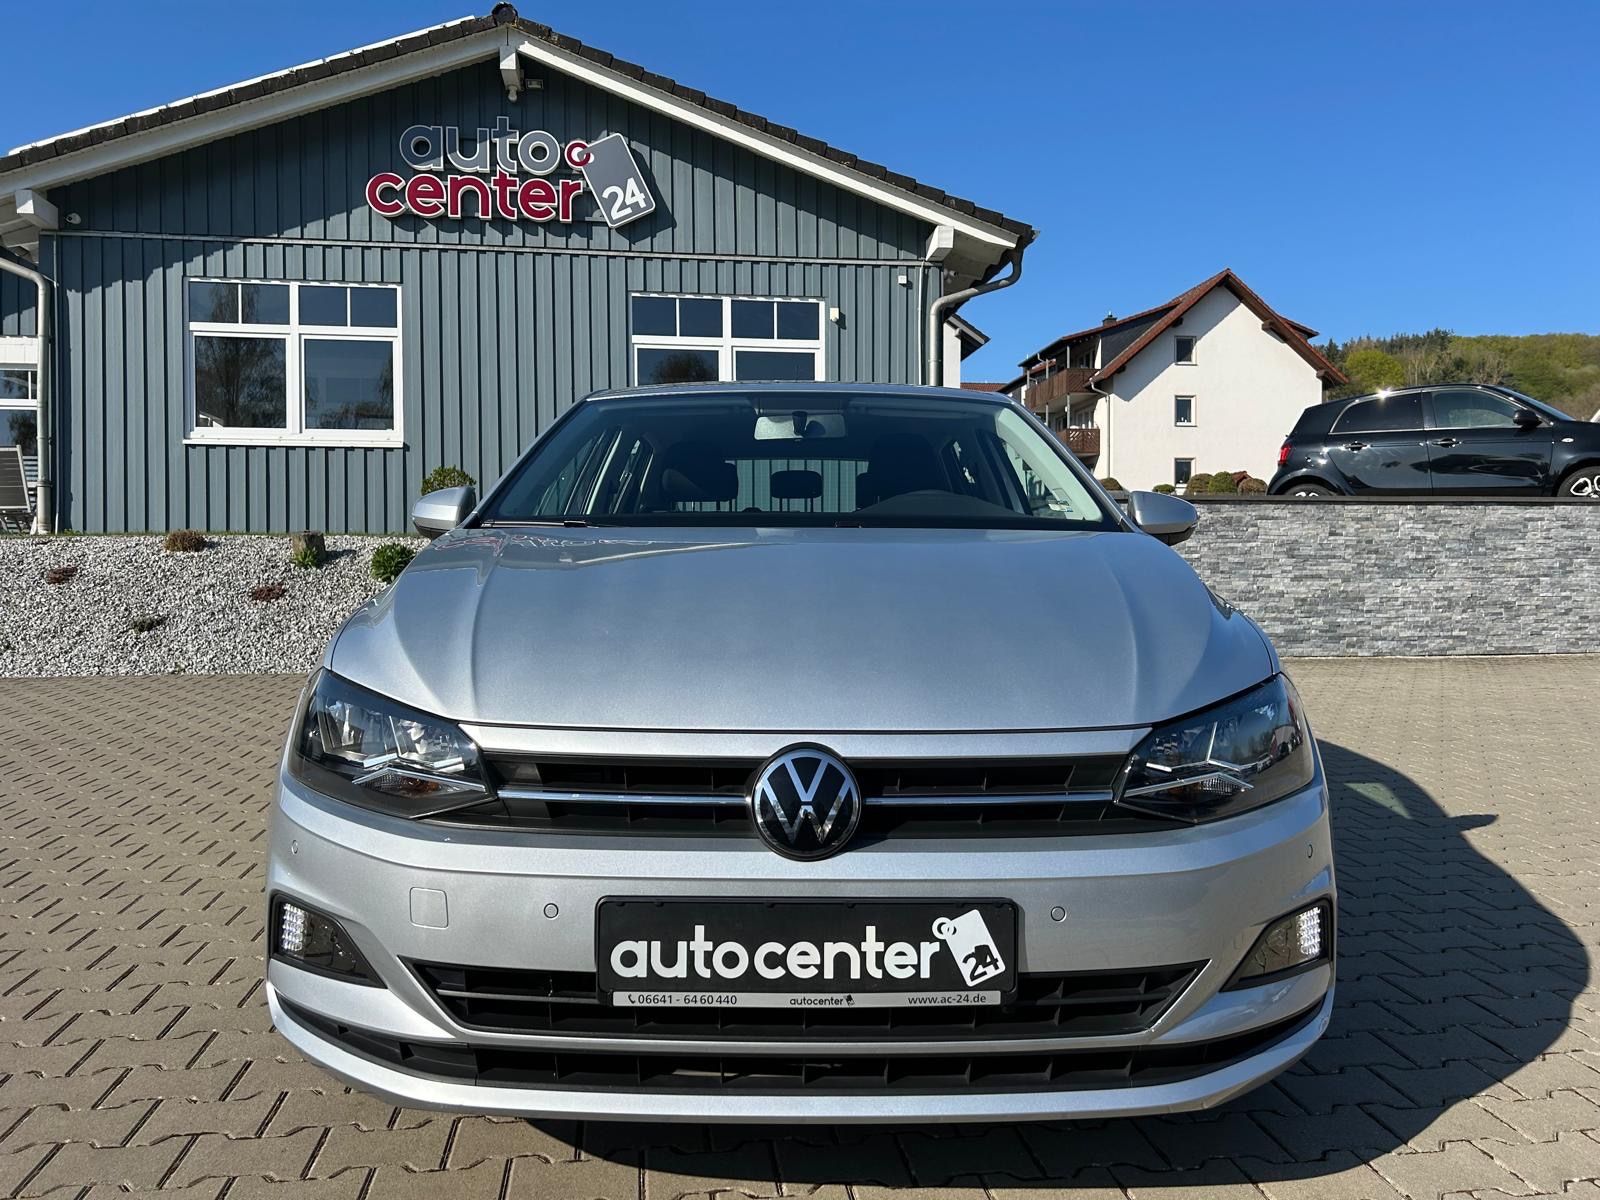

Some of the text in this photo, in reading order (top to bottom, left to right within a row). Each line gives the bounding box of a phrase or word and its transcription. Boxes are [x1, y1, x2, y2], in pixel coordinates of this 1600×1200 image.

[399, 116, 561, 176] auto
[365, 169, 583, 223] center
[602, 177, 646, 220] 24
[610, 925, 940, 979] autocenter
[962, 944, 1000, 981] 24
[789, 995, 844, 1007] autocenter
[907, 993, 987, 1006] www.ac-24.de
